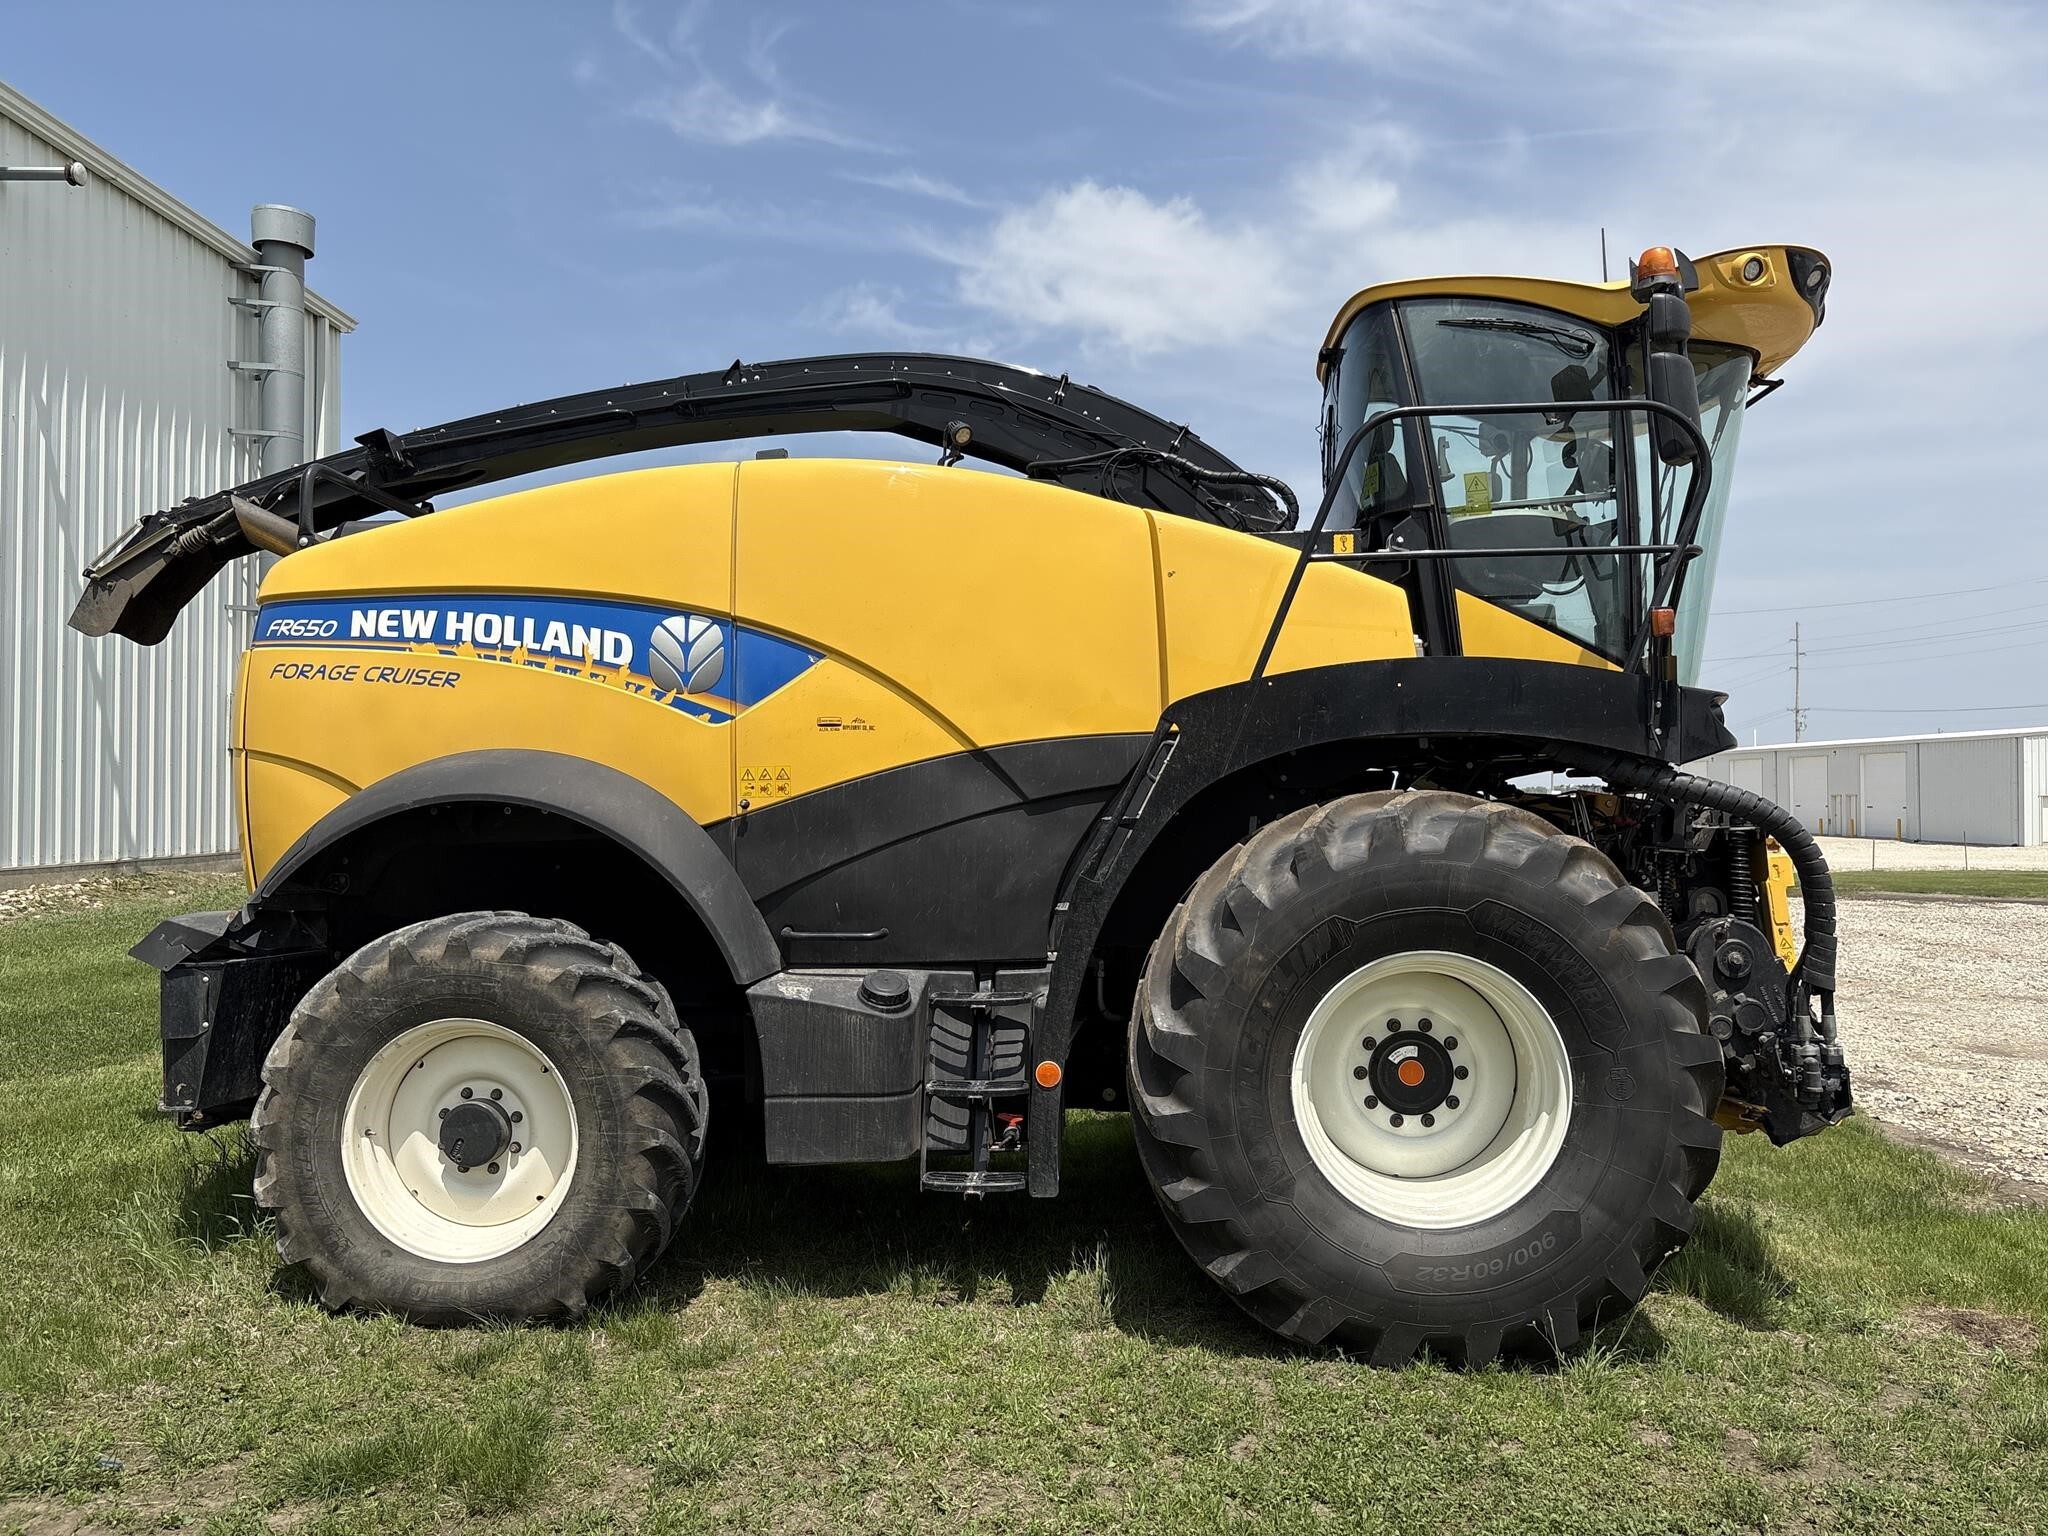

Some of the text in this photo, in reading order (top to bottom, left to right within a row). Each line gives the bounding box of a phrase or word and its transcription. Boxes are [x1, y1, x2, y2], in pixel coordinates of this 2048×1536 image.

[266, 618, 338, 637] FR650
[350, 609, 634, 666] NEW HOLLAND
[270, 663, 461, 689] FORAGE CRUISER
[1415, 1231, 1556, 1282] 900/60R32
